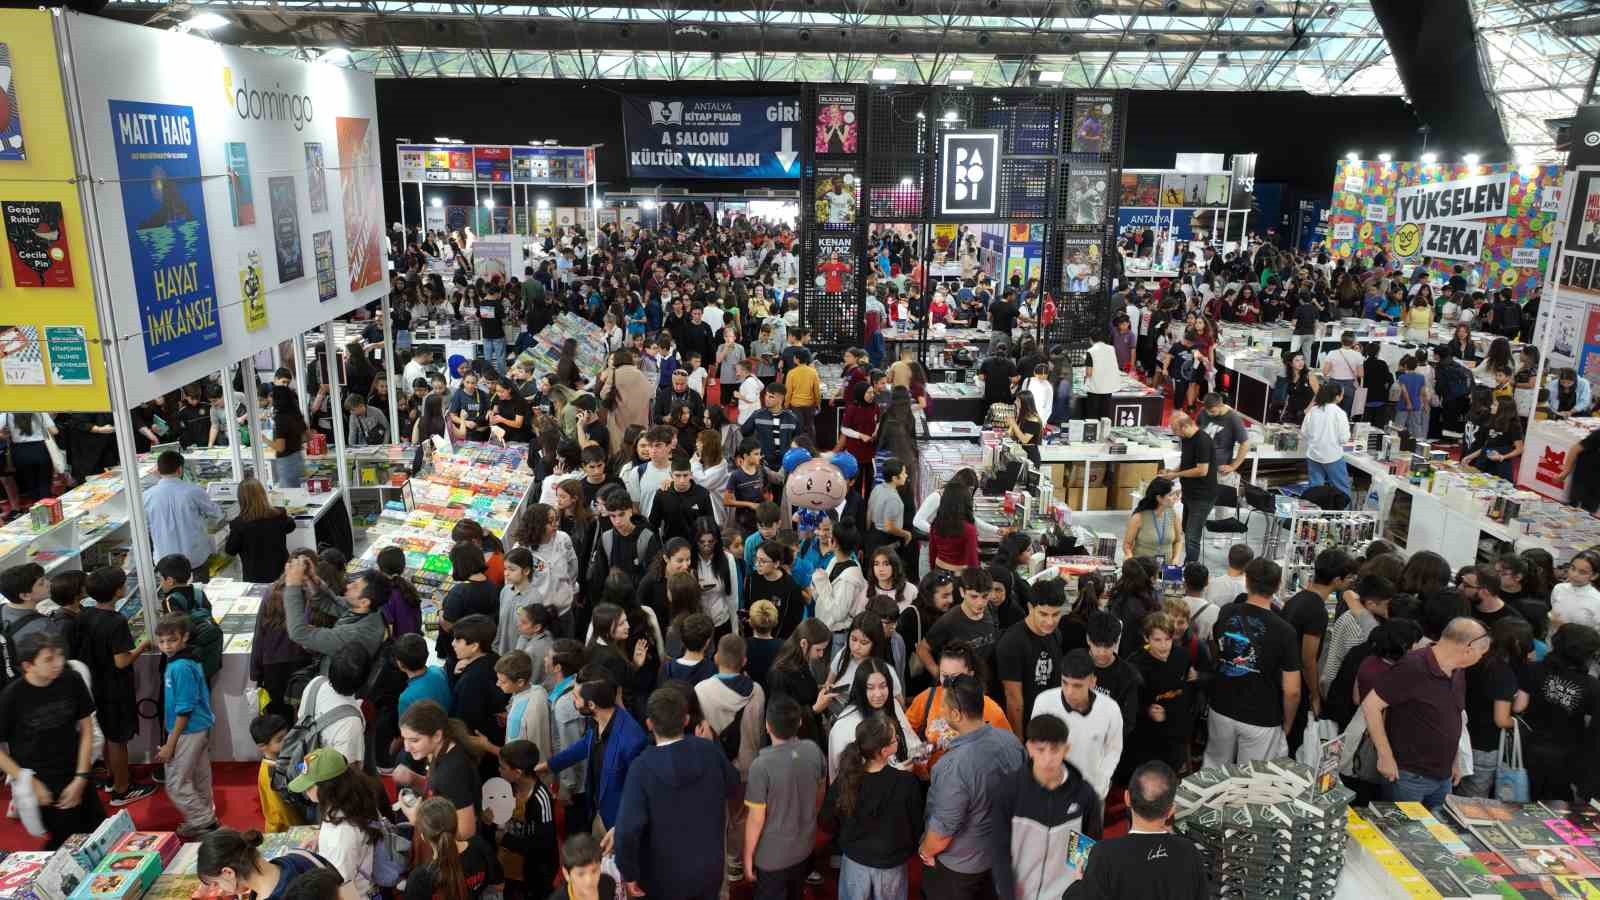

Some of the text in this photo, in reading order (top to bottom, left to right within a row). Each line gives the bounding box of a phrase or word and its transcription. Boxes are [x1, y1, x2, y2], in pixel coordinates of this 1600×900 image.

[235, 79, 313, 131] domingo
[694, 102, 732, 111] ANTALYA
[684, 111, 741, 122] KİTAP FUARI
[118, 112, 192, 146] MATT HAIG
[661, 131, 729, 146] A SALONU
[631, 148, 760, 167] KÜLTÜR YAYINLARI
[1400, 182, 1506, 221] YÜKSELEN
[7, 205, 40, 215] Gezgin
[10, 215, 40, 224] Ruhlar
[818, 237, 851, 246] KENAN
[1426, 224, 1478, 257] ZEKA
[18, 250, 47, 260] Cecile
[34, 259, 49, 268] Pin
[153, 261, 199, 301] HAYAT
[146, 297, 216, 347] İMKÂNSIZ
